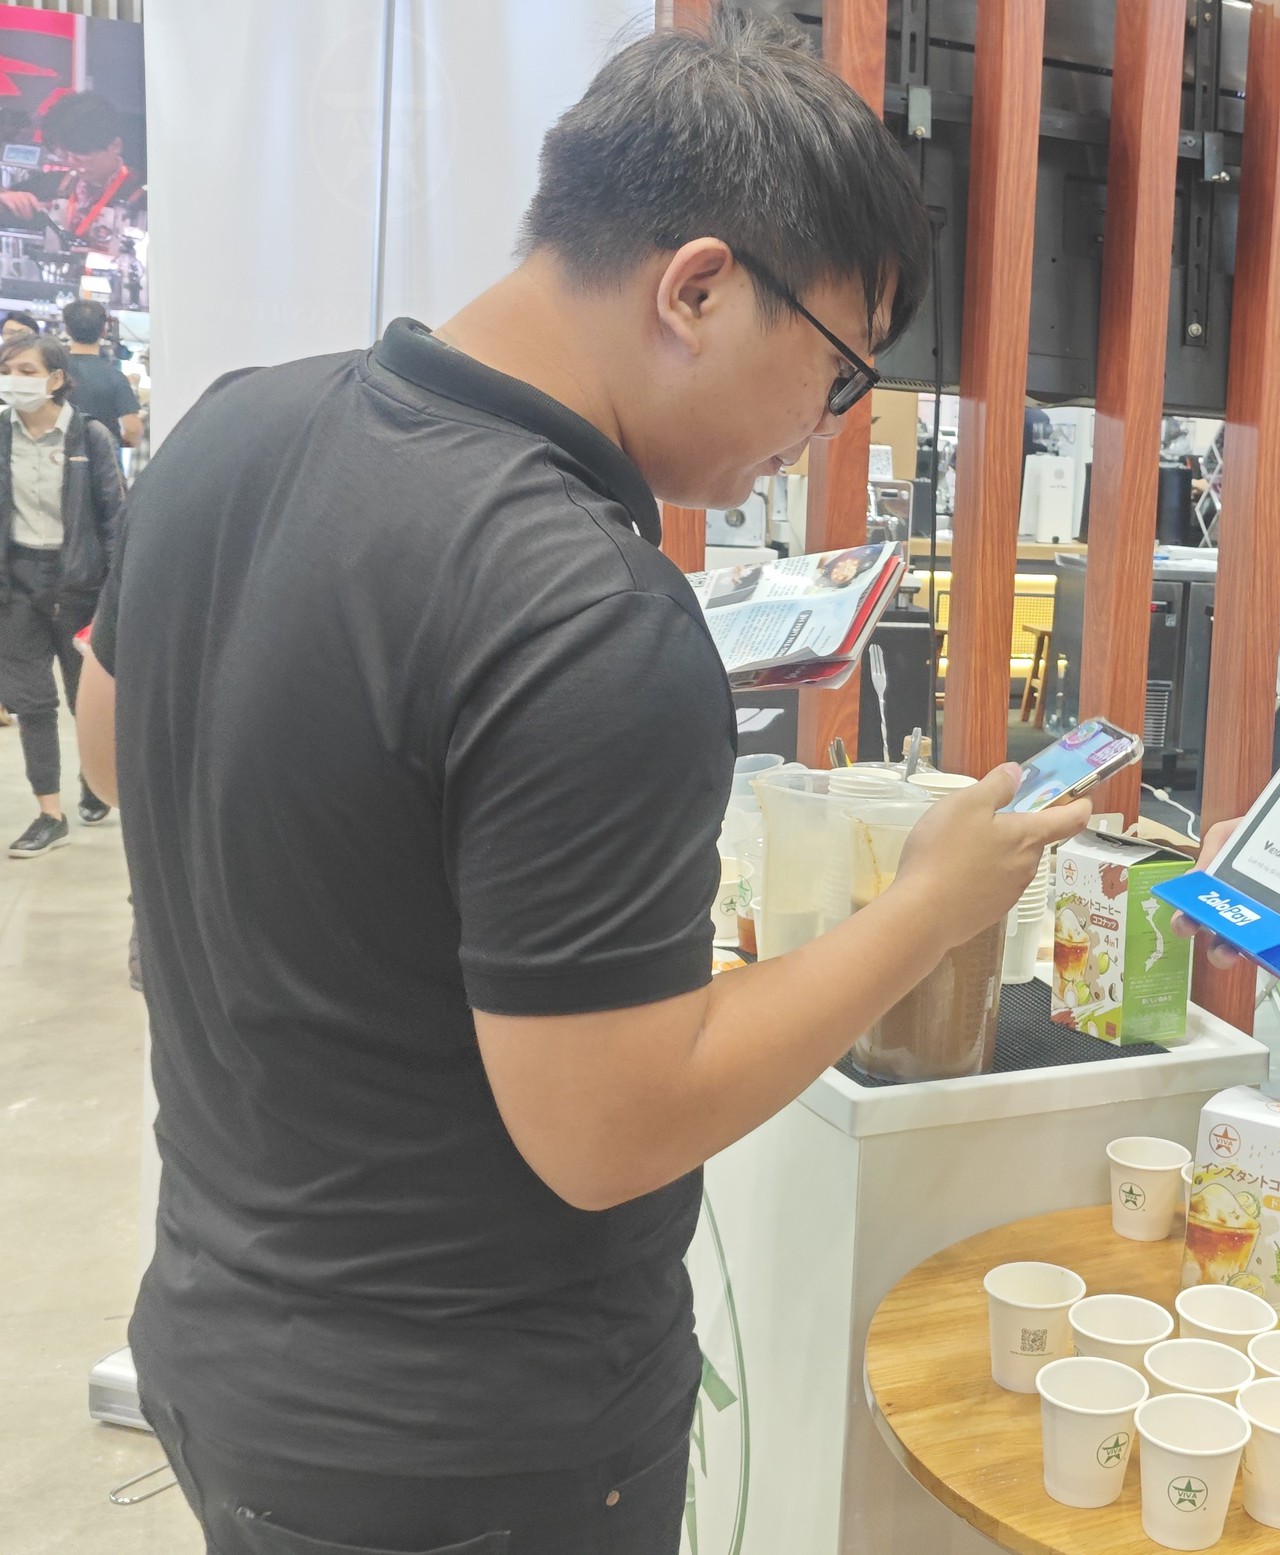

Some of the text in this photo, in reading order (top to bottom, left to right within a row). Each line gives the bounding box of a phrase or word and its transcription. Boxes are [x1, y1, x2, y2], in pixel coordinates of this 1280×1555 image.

[1197, 890, 1254, 924] ZaloPay
[1104, 934, 1119, 949] 4in1
[1215, 1137, 1233, 1147] VIVA
[1106, 1447, 1122, 1456] VIVA
[1177, 1490, 1198, 1499] VIVA
